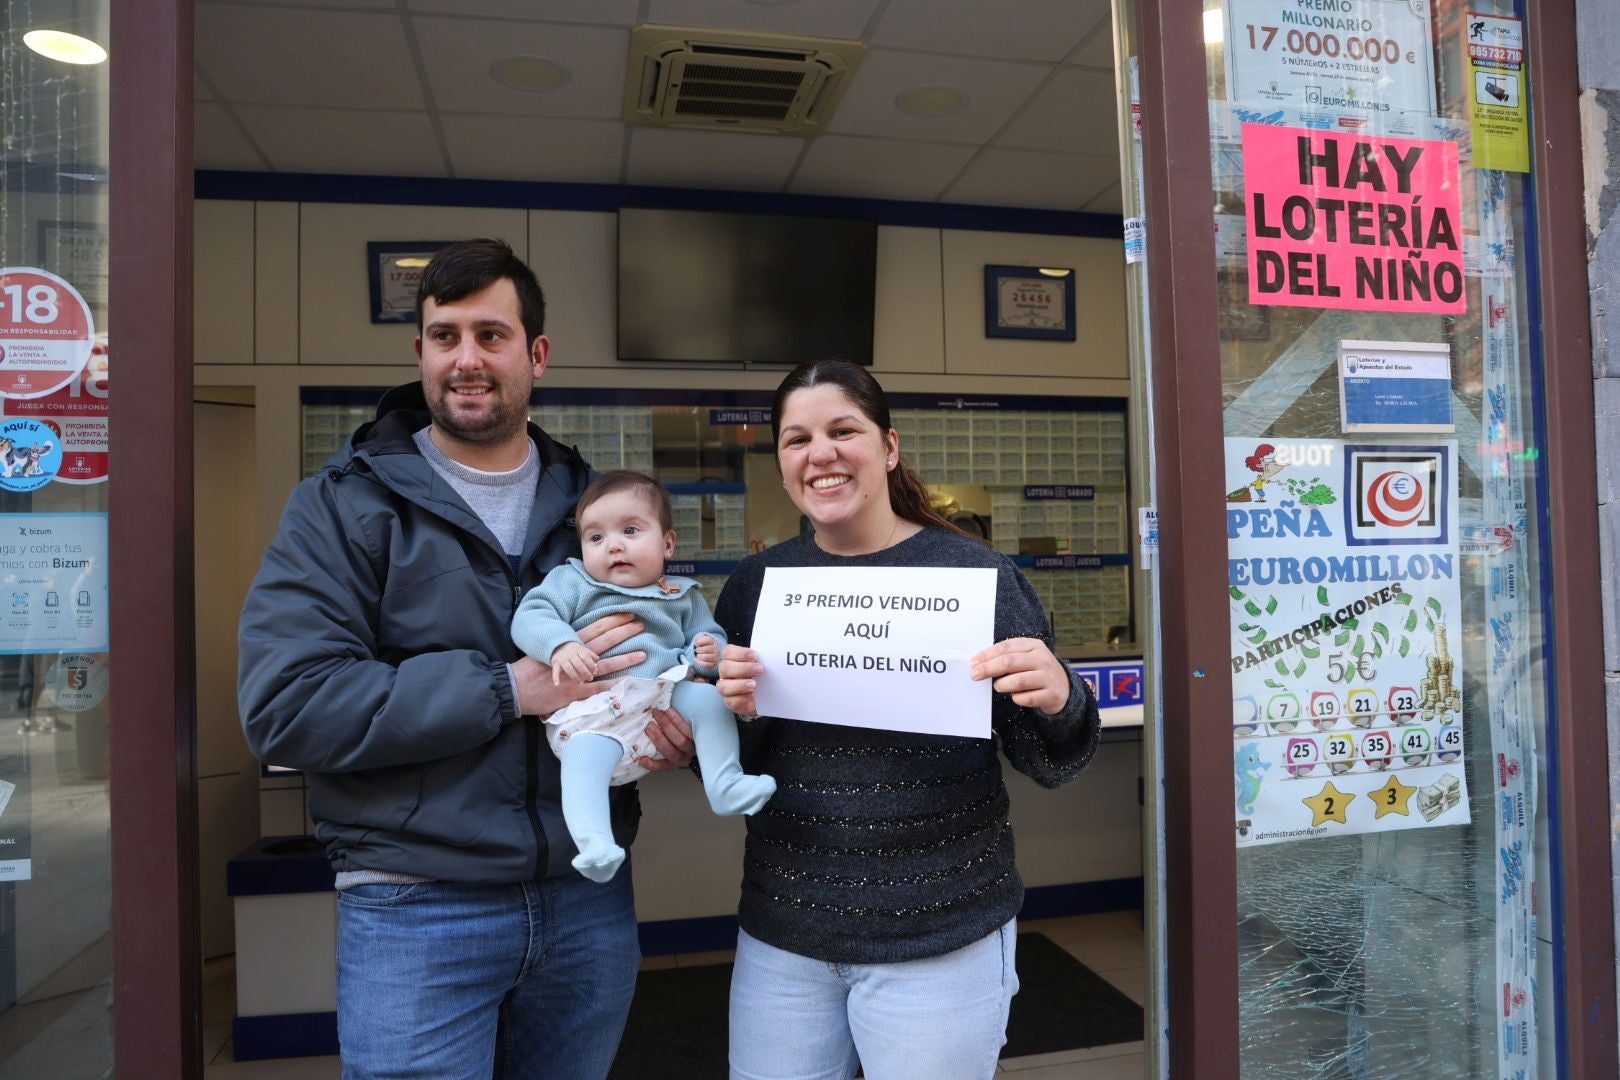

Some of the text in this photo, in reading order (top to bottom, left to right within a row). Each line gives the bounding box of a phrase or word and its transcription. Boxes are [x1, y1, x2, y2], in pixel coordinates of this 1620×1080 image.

[1282, 10, 1372, 32] MILLONARIO
[1246, 24, 1416, 65] 17.000.000 €
[1489, 48, 1506, 60] 732
[1506, 50, 1521, 61] 710
[1282, 57, 1287, 65] 5
[1289, 56, 1328, 69] NÚMEROS
[1323, 97, 1390, 112] EUROMILLONES
[1297, 135, 1424, 194] HAY
[1253, 192, 1458, 250] LOTERÍA
[1256, 250, 1463, 304] DEL NIÑO
[4, 421, 40, 433] AQUÍ SÍ
[717, 412, 748, 421] LOTERÍA
[1227, 500, 1333, 539] PEÑA
[20, 547, 26, 555] y
[31, 543, 60, 554] cobra
[65, 544, 82, 553] tus
[29, 561, 48, 569] con
[53, 557, 90, 568] Bizum
[666, 564, 695, 573] JUEVES
[1229, 553, 1453, 586] EUROMILLON
[783, 593, 960, 612] 3º PREMIO VENDIDO
[843, 621, 891, 640] AQUÍ
[1231, 582, 1404, 674] PARTICIPACIONES
[786, 651, 947, 674] LOTERIA DEL NIÑO
[1327, 650, 1377, 684] 5 €
[1280, 697, 1413, 717] 7 19 21 23
[1293, 731, 1460, 758] 25 32 35 41 45
[1324, 788, 1397, 815] 2 3
[1517, 791, 1525, 828] ALQUILA
